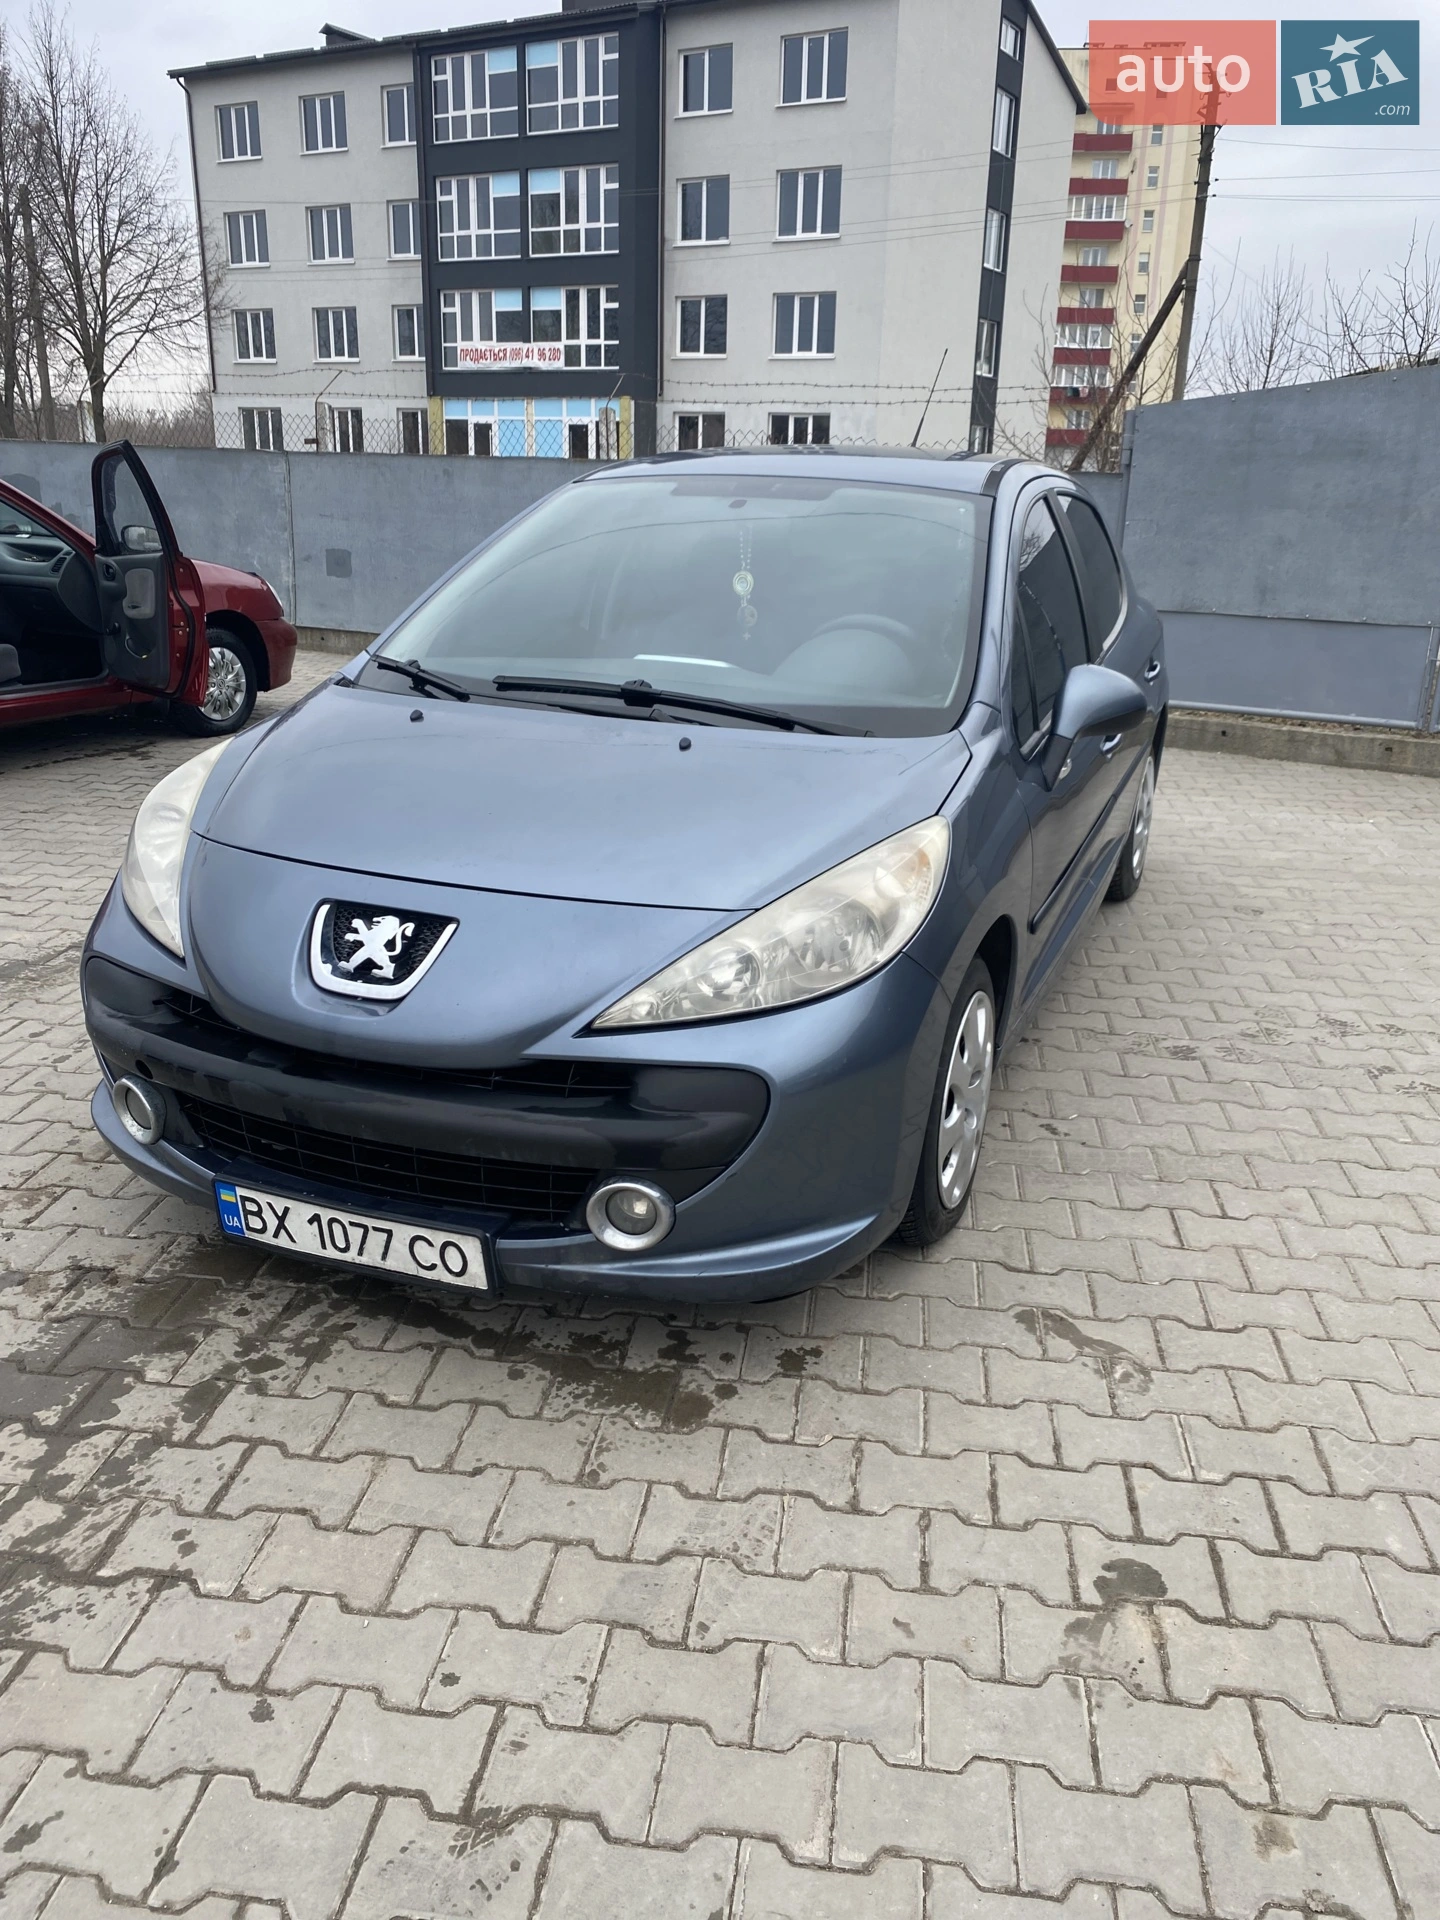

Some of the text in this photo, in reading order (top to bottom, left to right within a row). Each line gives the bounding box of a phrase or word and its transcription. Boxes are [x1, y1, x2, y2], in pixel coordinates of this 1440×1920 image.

[460, 347, 508, 364] ПРОДАЄТЬСЯ
[525, 348, 534, 360] 41
[537, 348, 547, 361] 96
[547, 348, 561, 361] 280
[224, 1213, 241, 1229] UA
[239, 1194, 469, 1278] BX 1077 CO
